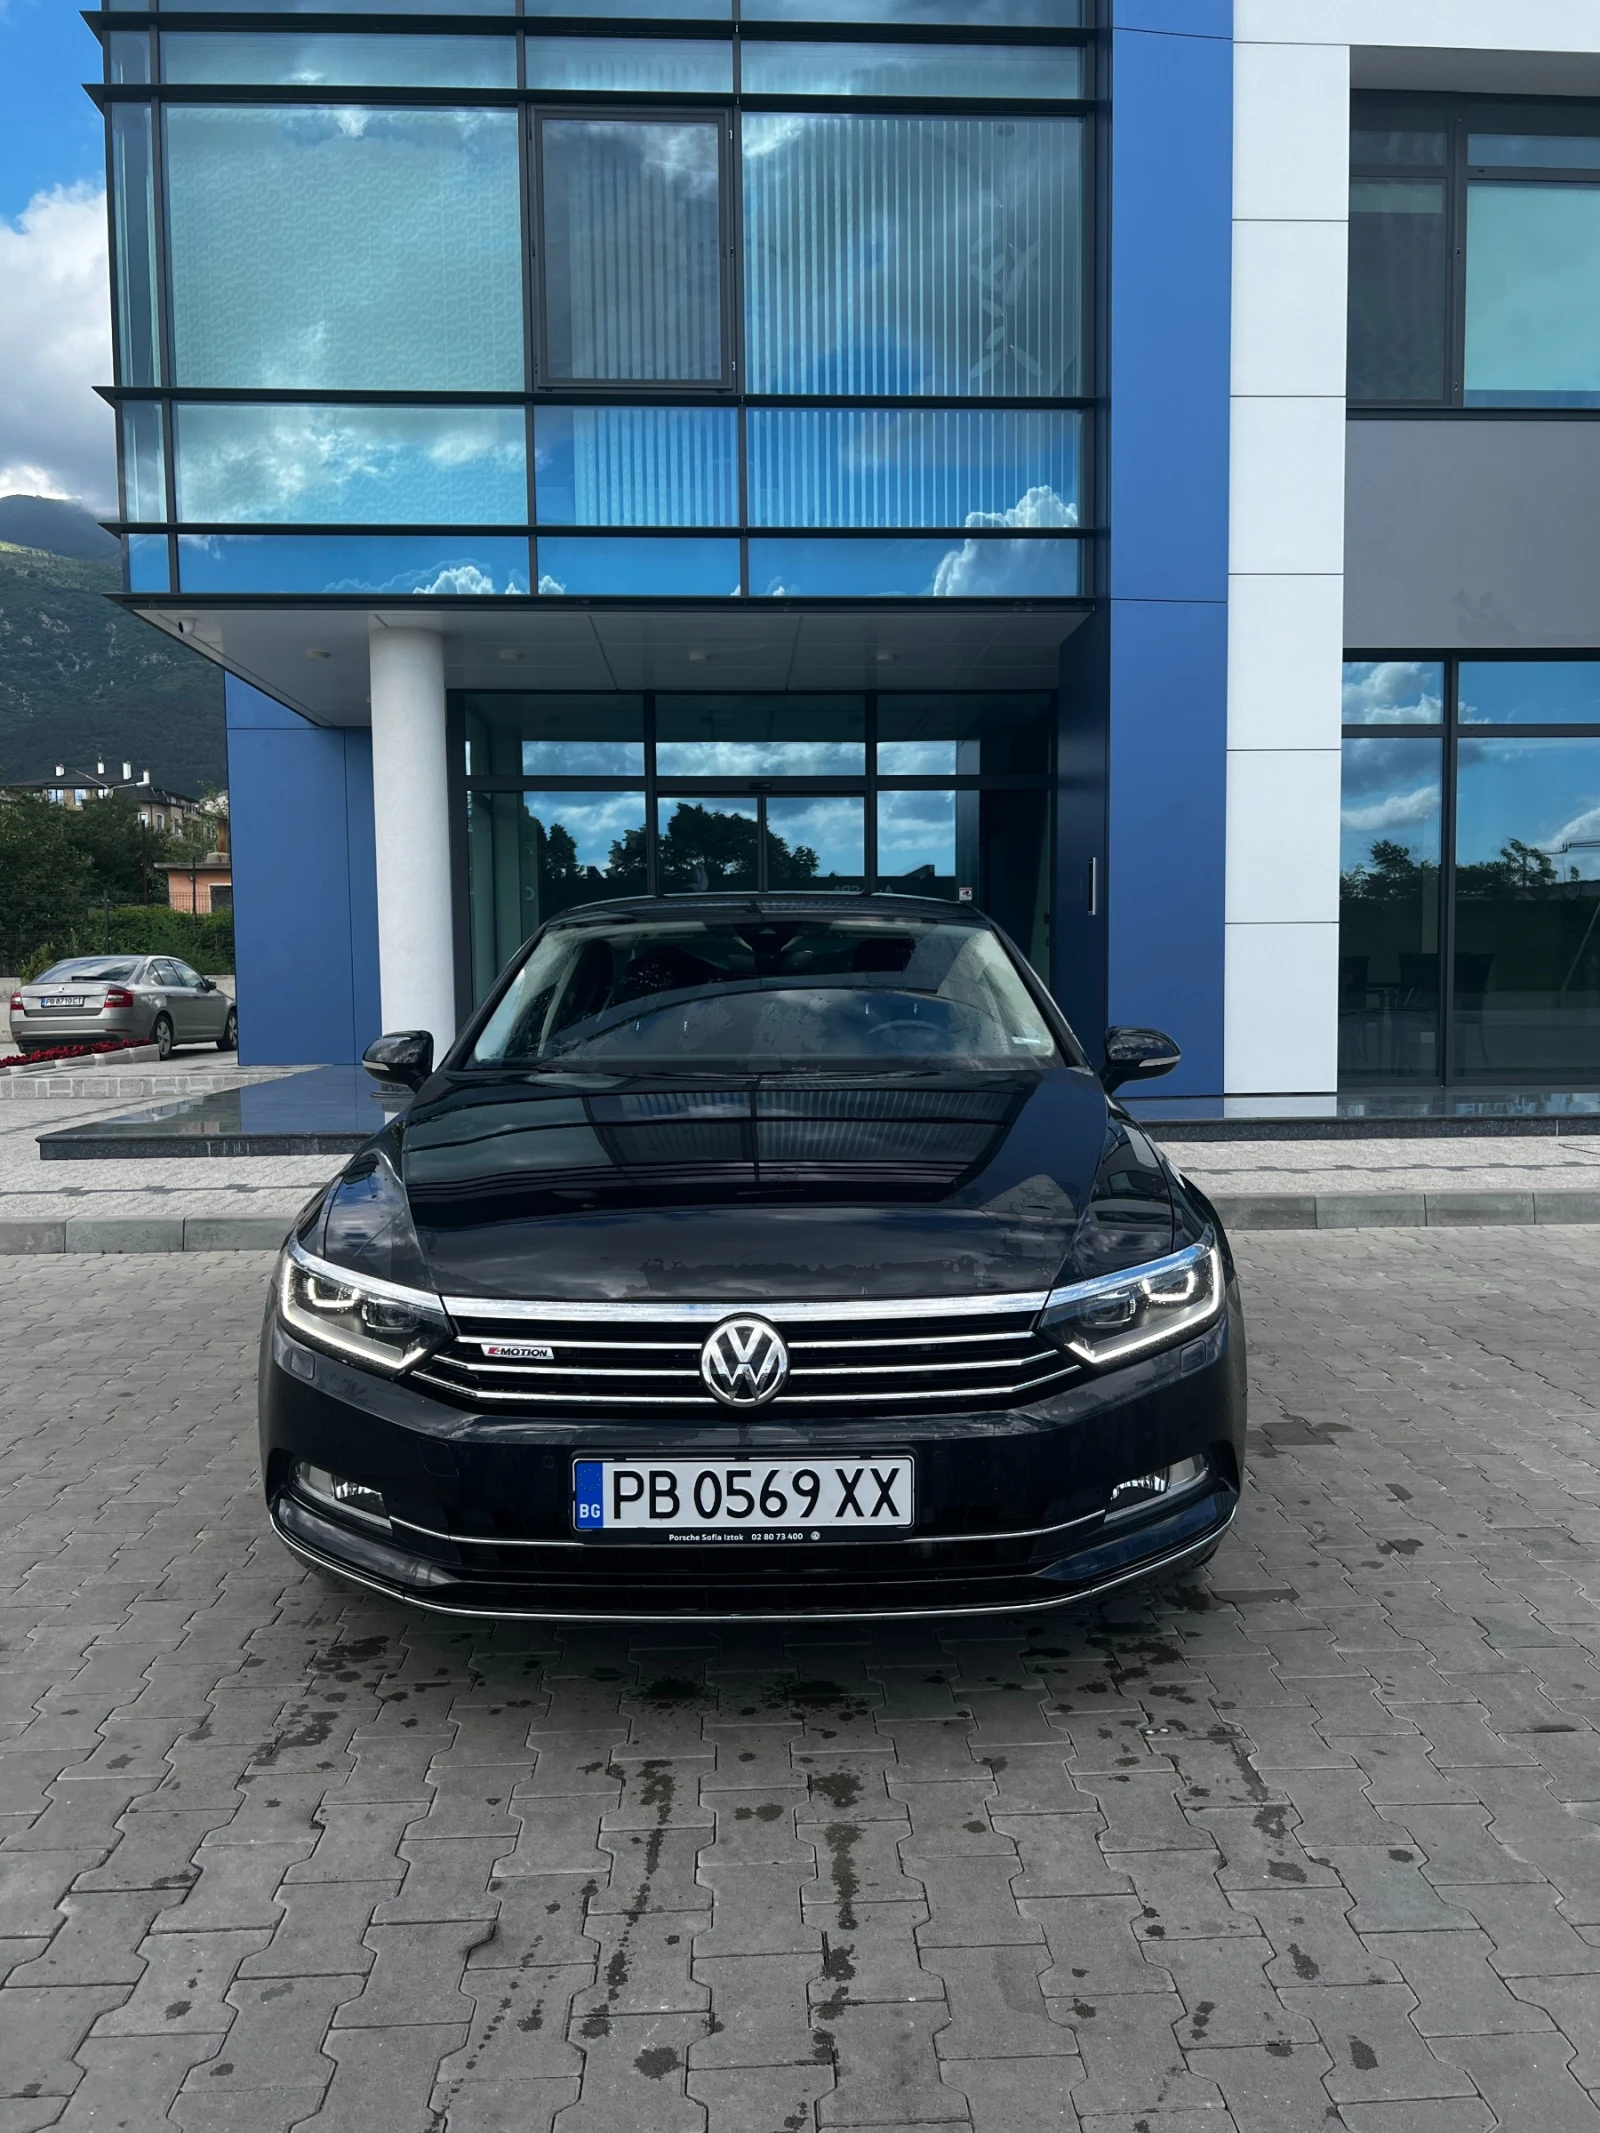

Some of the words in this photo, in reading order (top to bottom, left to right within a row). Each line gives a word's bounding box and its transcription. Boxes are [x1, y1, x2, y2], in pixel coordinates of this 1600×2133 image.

[613, 1470, 681, 1520] PB
[693, 1468, 821, 1520] 0569
[834, 1467, 901, 1518] XX
[580, 1504, 600, 1518] BG
[669, 1533, 700, 1541] Porsche
[702, 1533, 722, 1541] Sofia
[724, 1533, 744, 1541] Iztok
[751, 1533, 762, 1541] 02
[763, 1533, 774, 1541] 80
[776, 1533, 786, 1541] 73
[787, 1532, 804, 1540] 400
